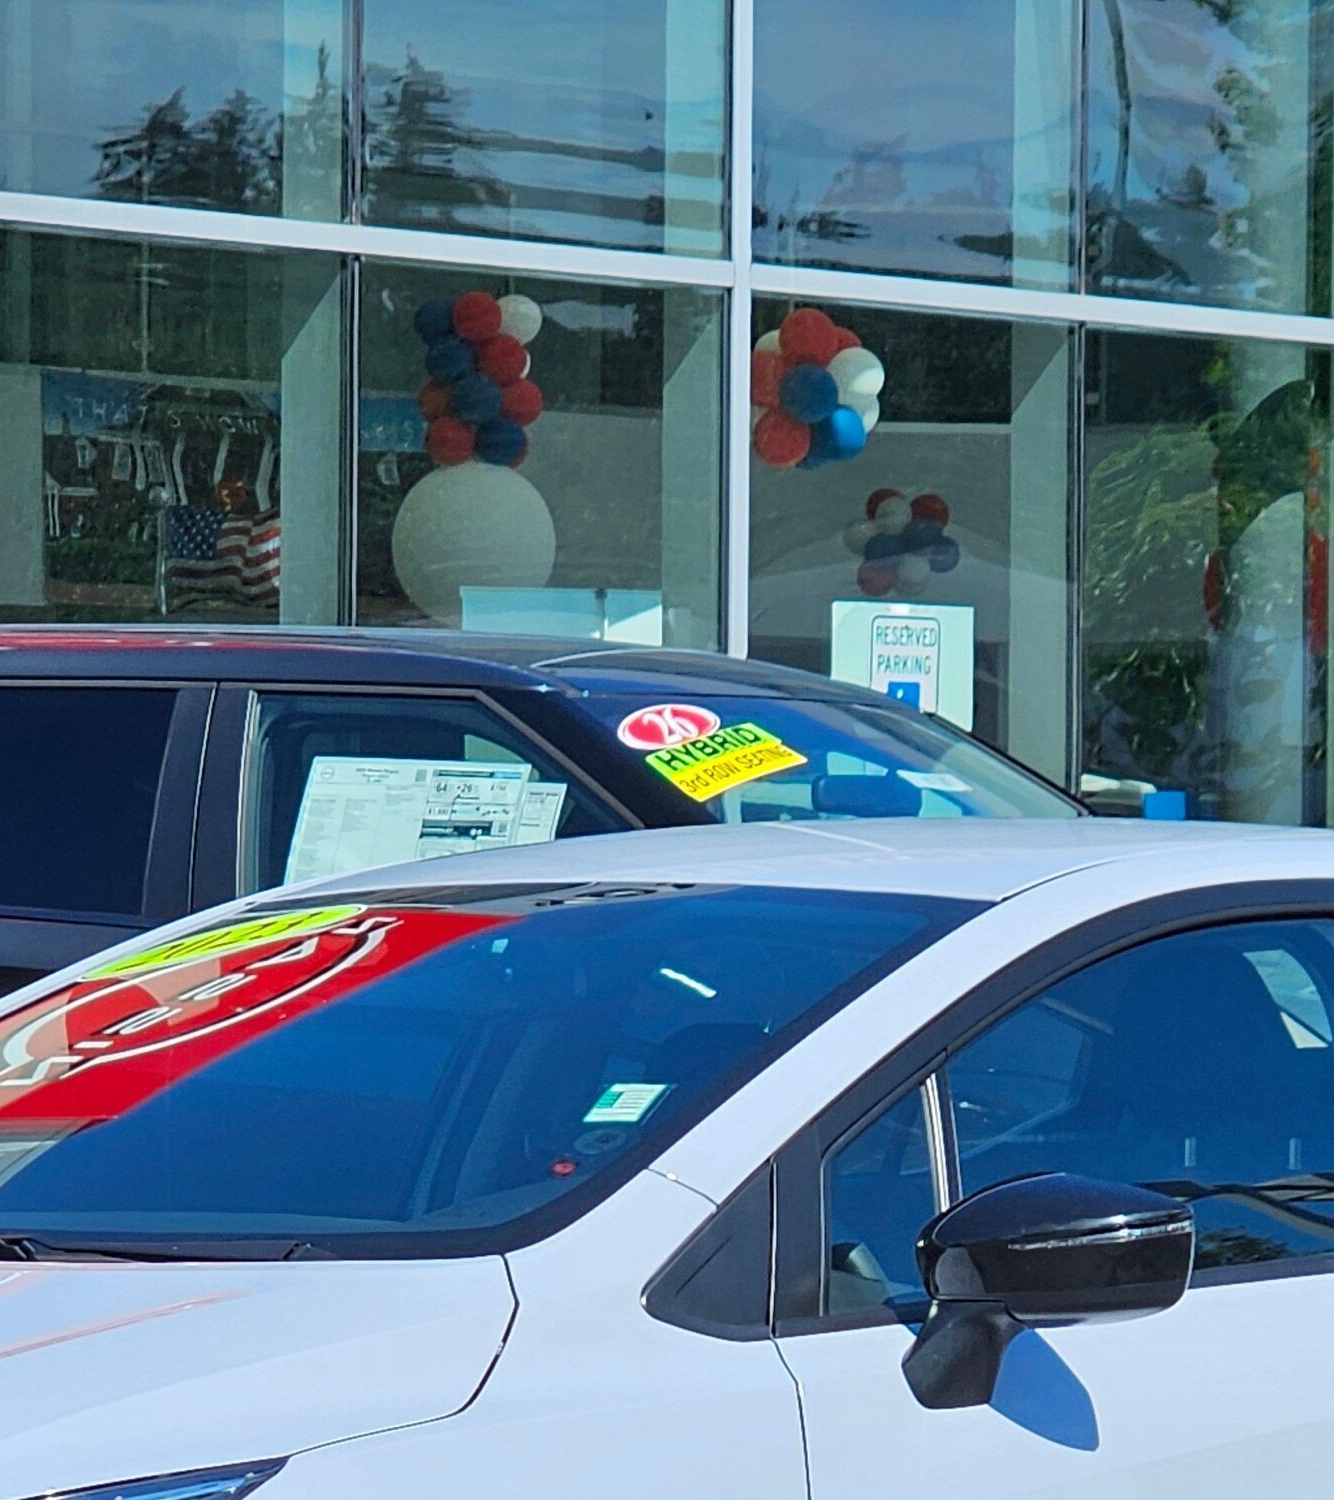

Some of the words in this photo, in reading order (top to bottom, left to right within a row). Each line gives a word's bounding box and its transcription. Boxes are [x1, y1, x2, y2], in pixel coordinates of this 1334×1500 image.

[875, 625, 938, 647] RESERVED
[877, 654, 931, 676] PARKING
[641, 706, 699, 745] 26
[654, 726, 763, 772] HYBRID
[678, 773, 710, 794] 3rd
[703, 761, 741, 783] ROW
[734, 745, 793, 770] SEATING
